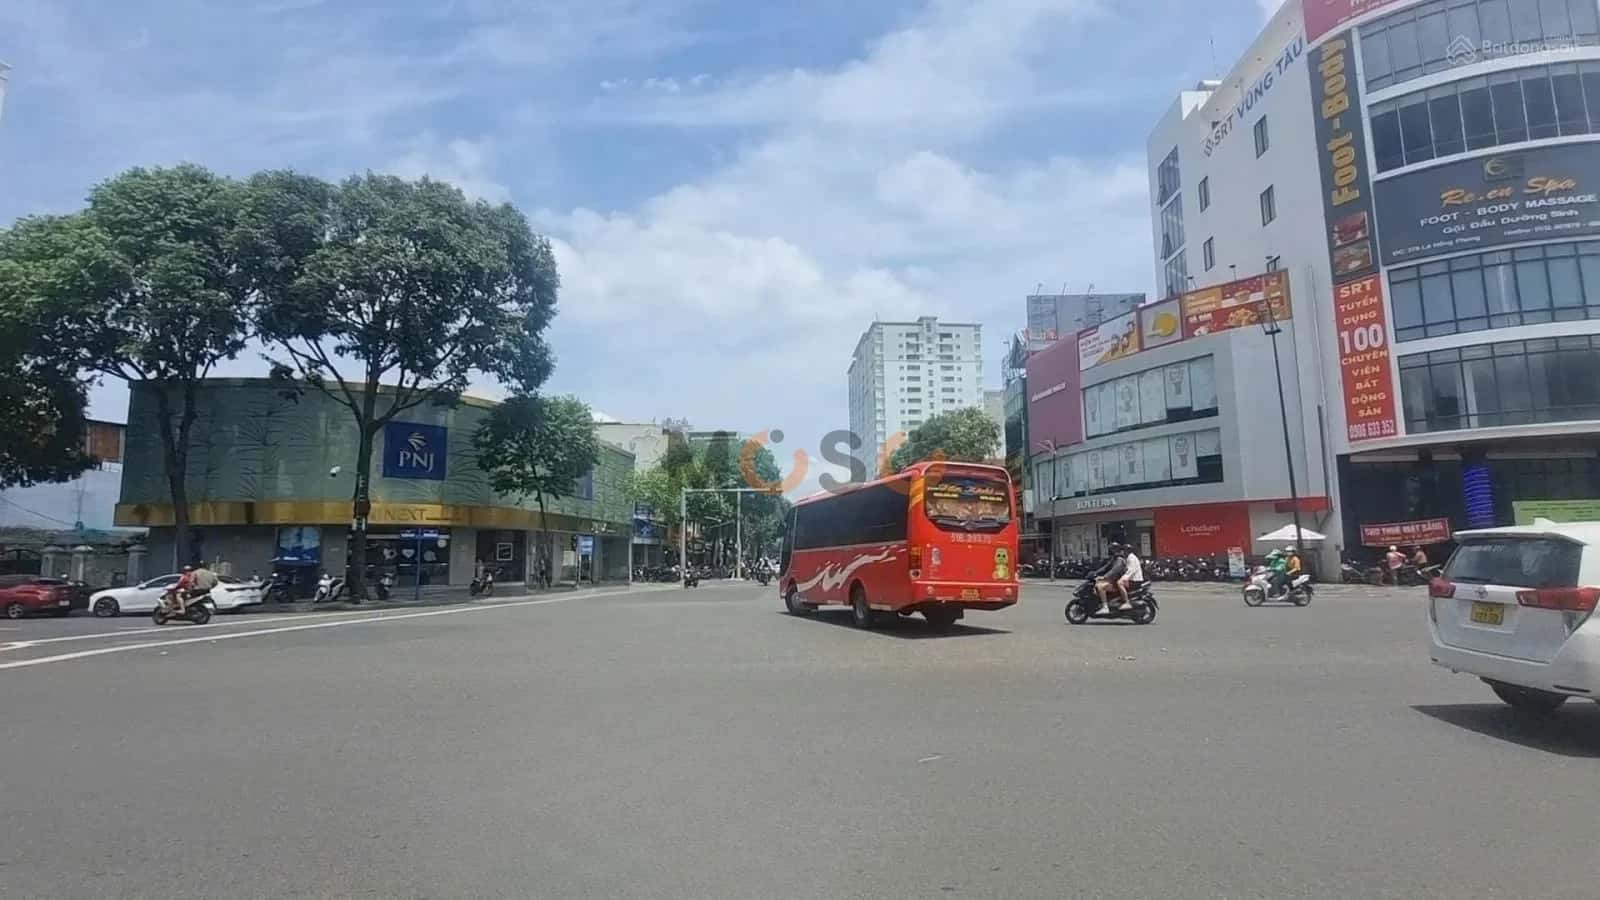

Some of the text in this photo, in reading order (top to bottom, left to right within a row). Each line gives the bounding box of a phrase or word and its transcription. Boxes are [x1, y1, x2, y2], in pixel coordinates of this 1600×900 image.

[1318, 39, 1350, 120] Body
[1214, 114, 1234, 146] SRT
[1275, 37, 1304, 77] TÀU
[1328, 131, 1360, 207] Foot
[1420, 211, 1460, 227] FOOT
[1477, 202, 1520, 217] BODY
[1525, 193, 1598, 209] MASSAGE
[1550, 209, 1580, 219] Sinh
[1340, 279, 1374, 298] SRT
[1340, 323, 1384, 354] 100
[1341, 350, 1388, 366] CHUYÊN
[1351, 365, 1380, 377] VIÊN
[398, 450, 435, 473] PNJ
[383, 508, 428, 521] NEXT
